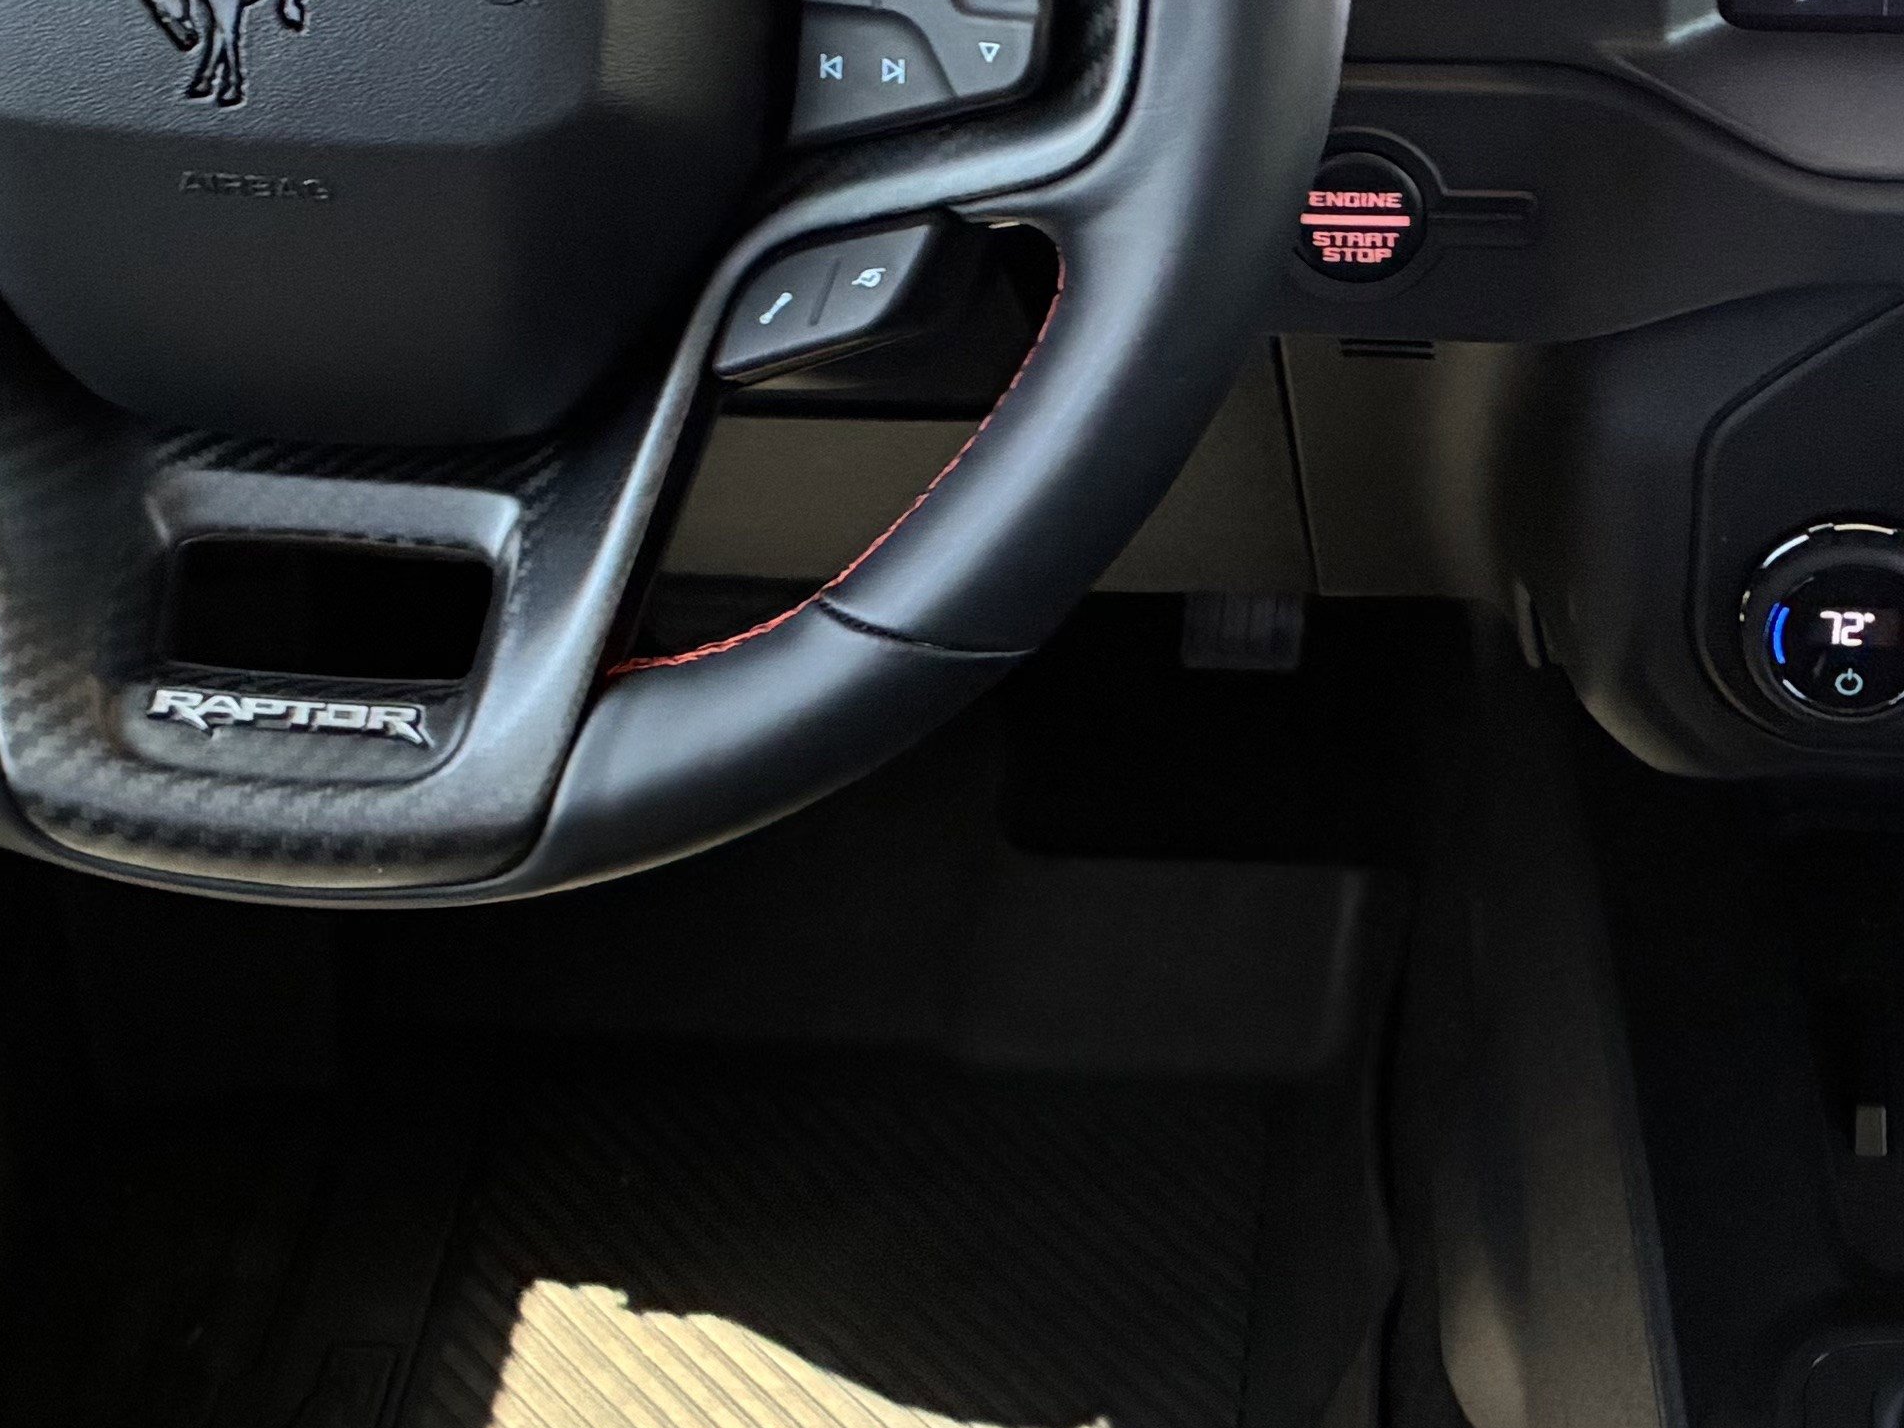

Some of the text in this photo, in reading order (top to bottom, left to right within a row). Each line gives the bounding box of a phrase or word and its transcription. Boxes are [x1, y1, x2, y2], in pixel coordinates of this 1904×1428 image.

[1308, 191, 1403, 208] ENGINE
[1312, 231, 1400, 248] START
[1322, 247, 1392, 263] STOP
[146, 687, 430, 747] RAPTOR
